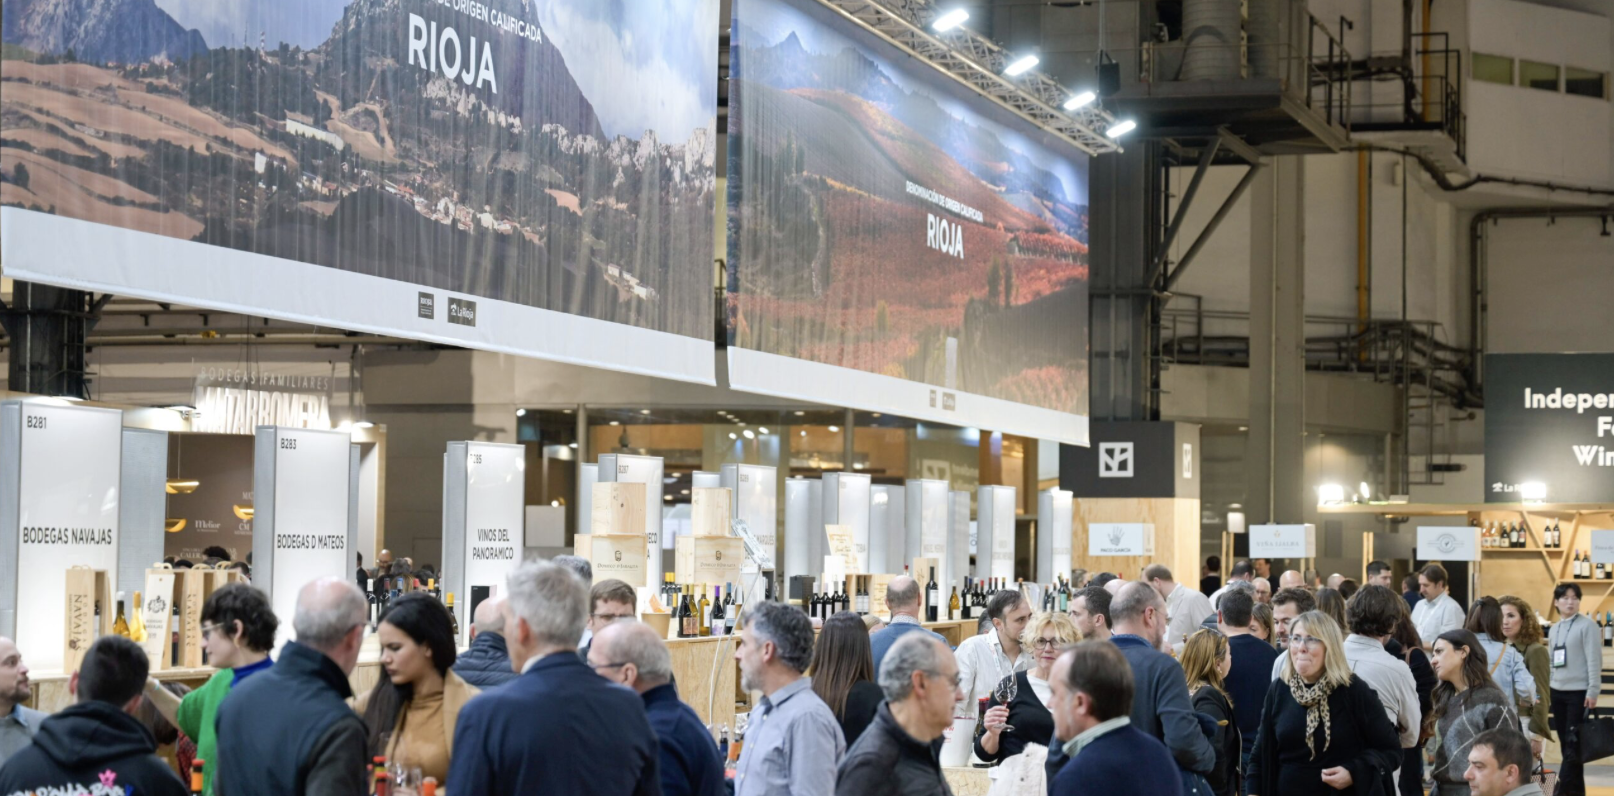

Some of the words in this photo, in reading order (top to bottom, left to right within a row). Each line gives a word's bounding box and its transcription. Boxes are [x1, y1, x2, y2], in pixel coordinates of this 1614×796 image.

[453, 0, 488, 22] ORIGEN
[490, 9, 542, 44] CALIFICADA
[408, 12, 497, 94] RIOJA
[927, 213, 964, 259] RIOJA
[201, 366, 256, 384] BODEGAS
[263, 372, 328, 390] FAMILIARES
[27, 415, 47, 429] B281
[280, 438, 297, 449] B283
[23, 527, 69, 544] BODEGAS
[71, 528, 112, 545] NAVAJAS
[277, 534, 310, 549] BODEGAS
[311, 535, 316, 549] D
[318, 535, 345, 549] MATEOS
[478, 529, 497, 541] VINOS
[497, 529, 509, 541] DEL
[472, 547, 513, 560] PANORAMICO
[73, 594, 82, 652] NAVAJAS
